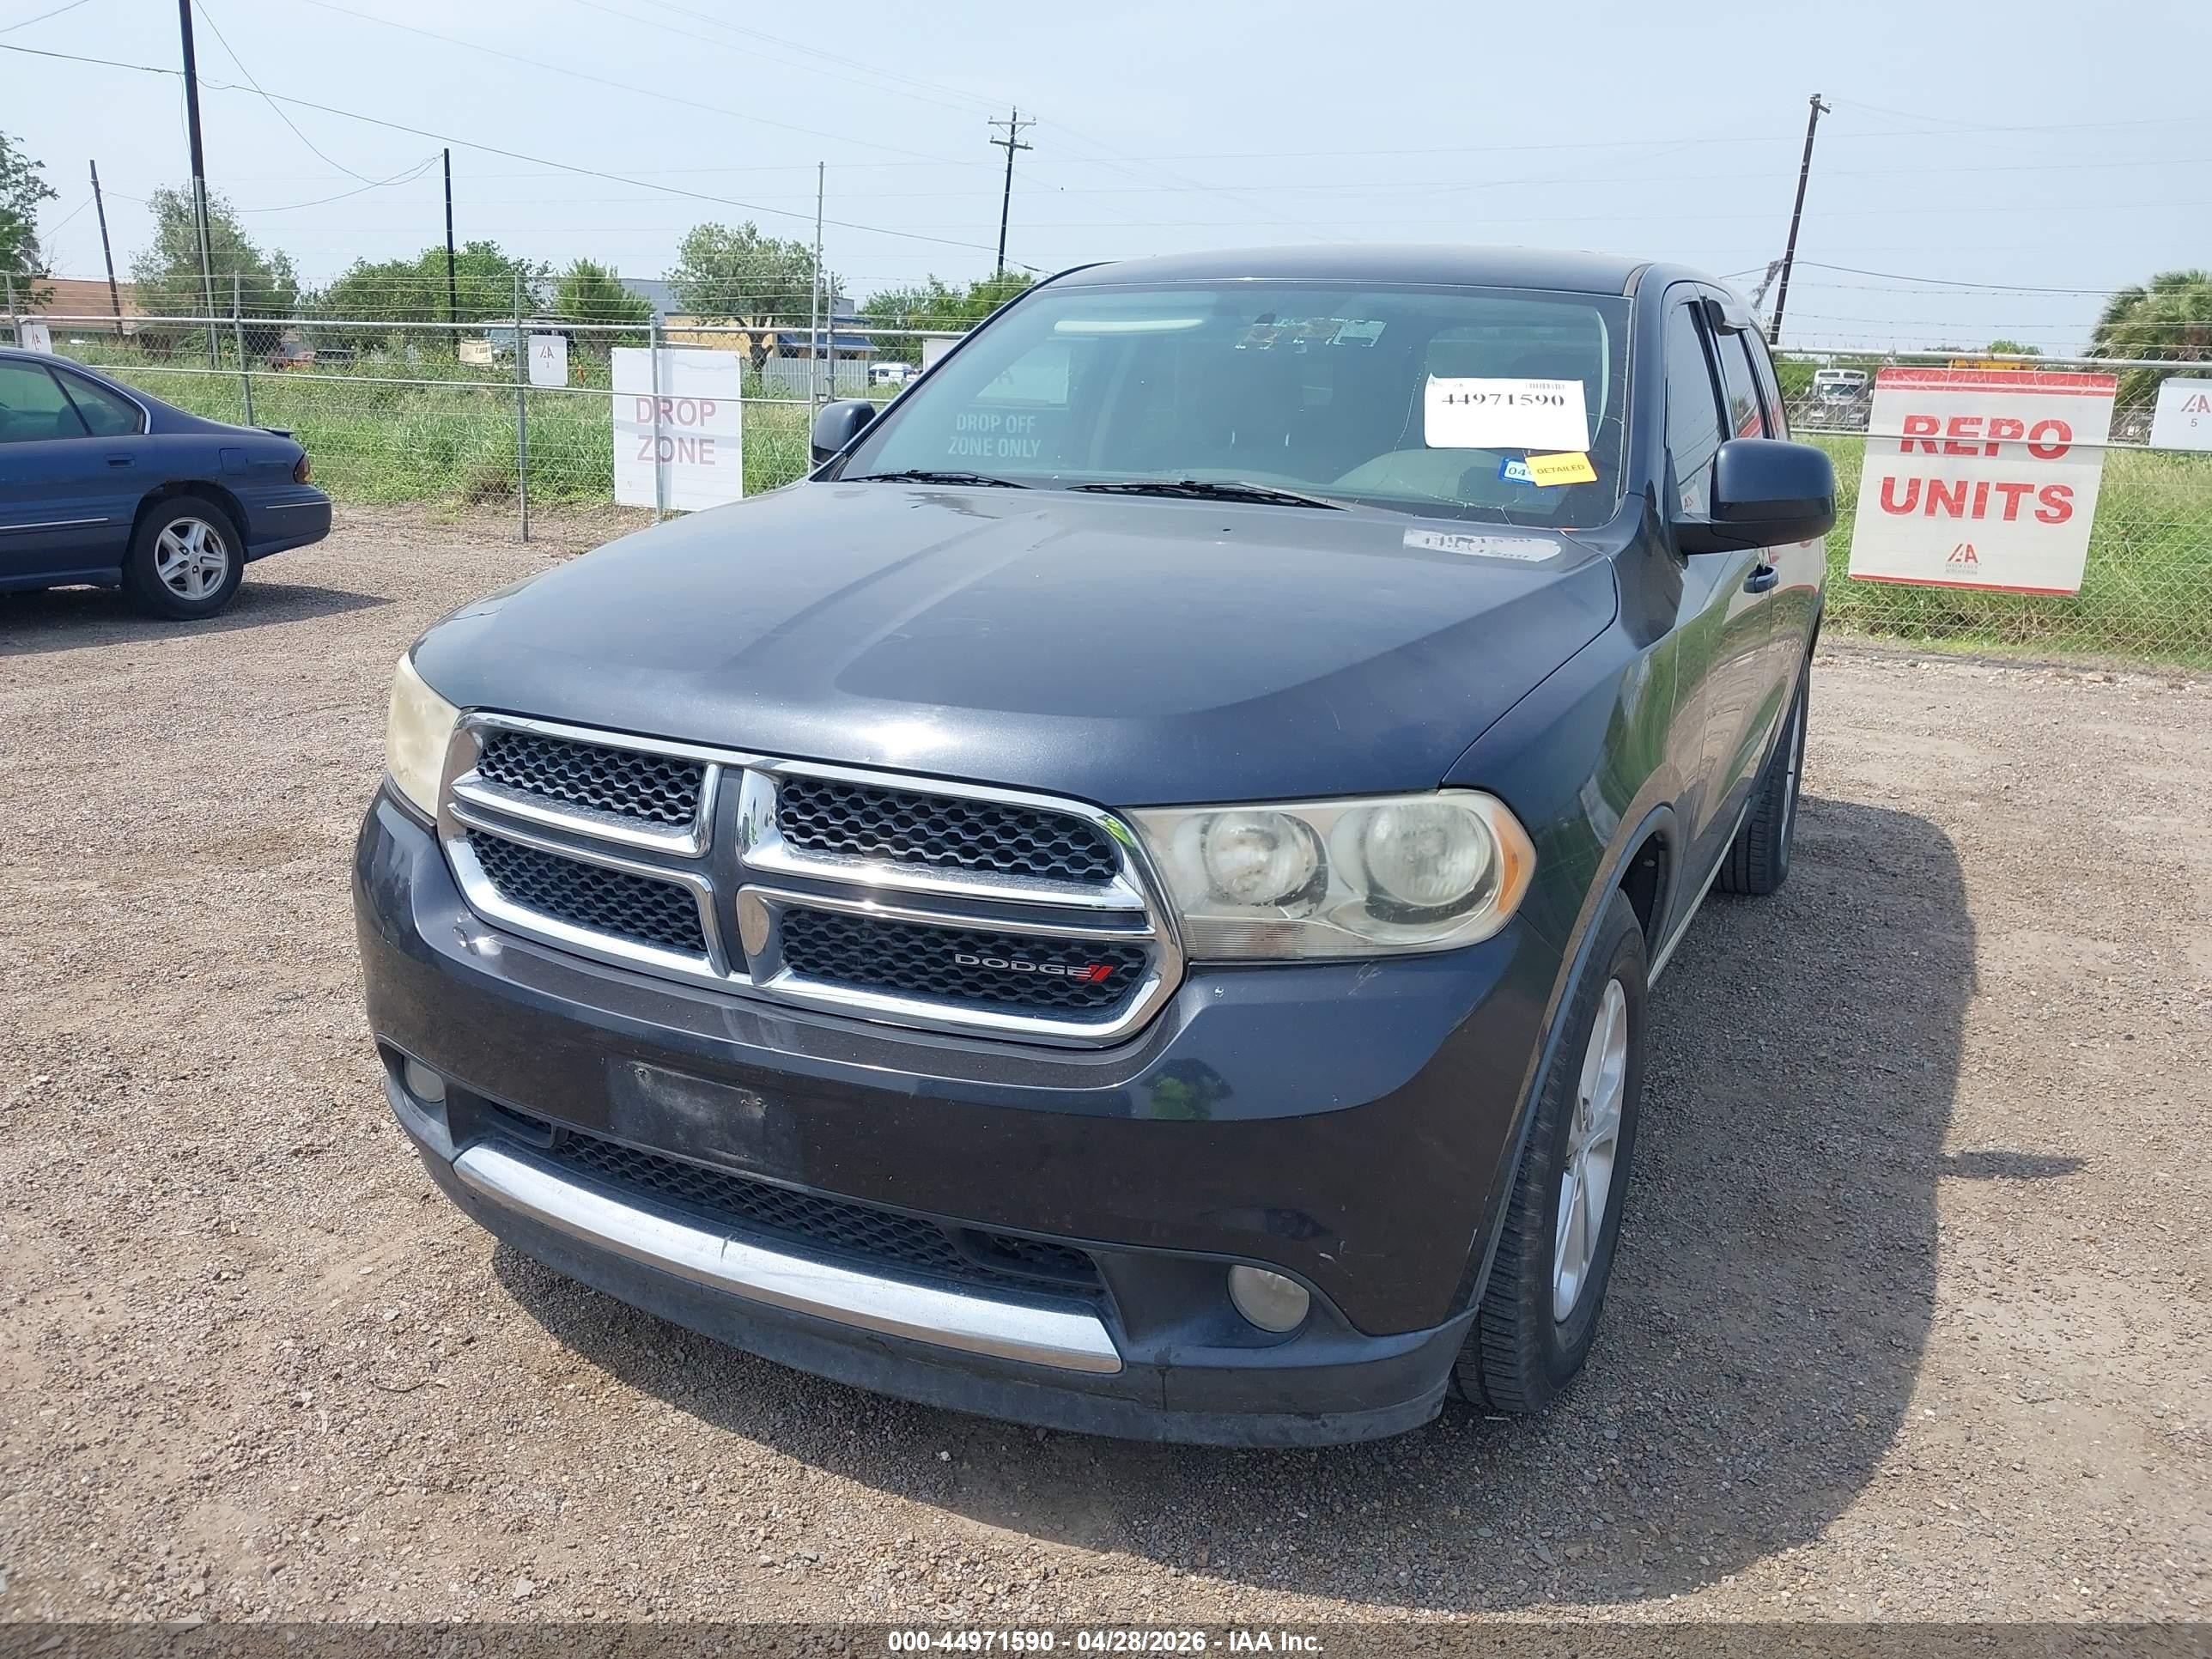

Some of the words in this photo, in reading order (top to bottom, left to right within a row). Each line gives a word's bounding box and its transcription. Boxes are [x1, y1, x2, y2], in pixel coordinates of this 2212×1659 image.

[1442, 393, 1565, 406] 44971590
[635, 398, 716, 427] DROP
[956, 412, 1001, 433] DROP
[1006, 415, 1036, 434] OFF
[2190, 417, 2198, 428] 5
[947, 435, 994, 457] ZONE
[998, 438, 1042, 458] ONLY
[1899, 414, 2073, 460] REPO
[636, 434, 716, 466] ZONE
[1536, 464, 1586, 475] DETAILED
[1879, 476, 2075, 525] UNITS
[954, 953, 1091, 978] DODGE
